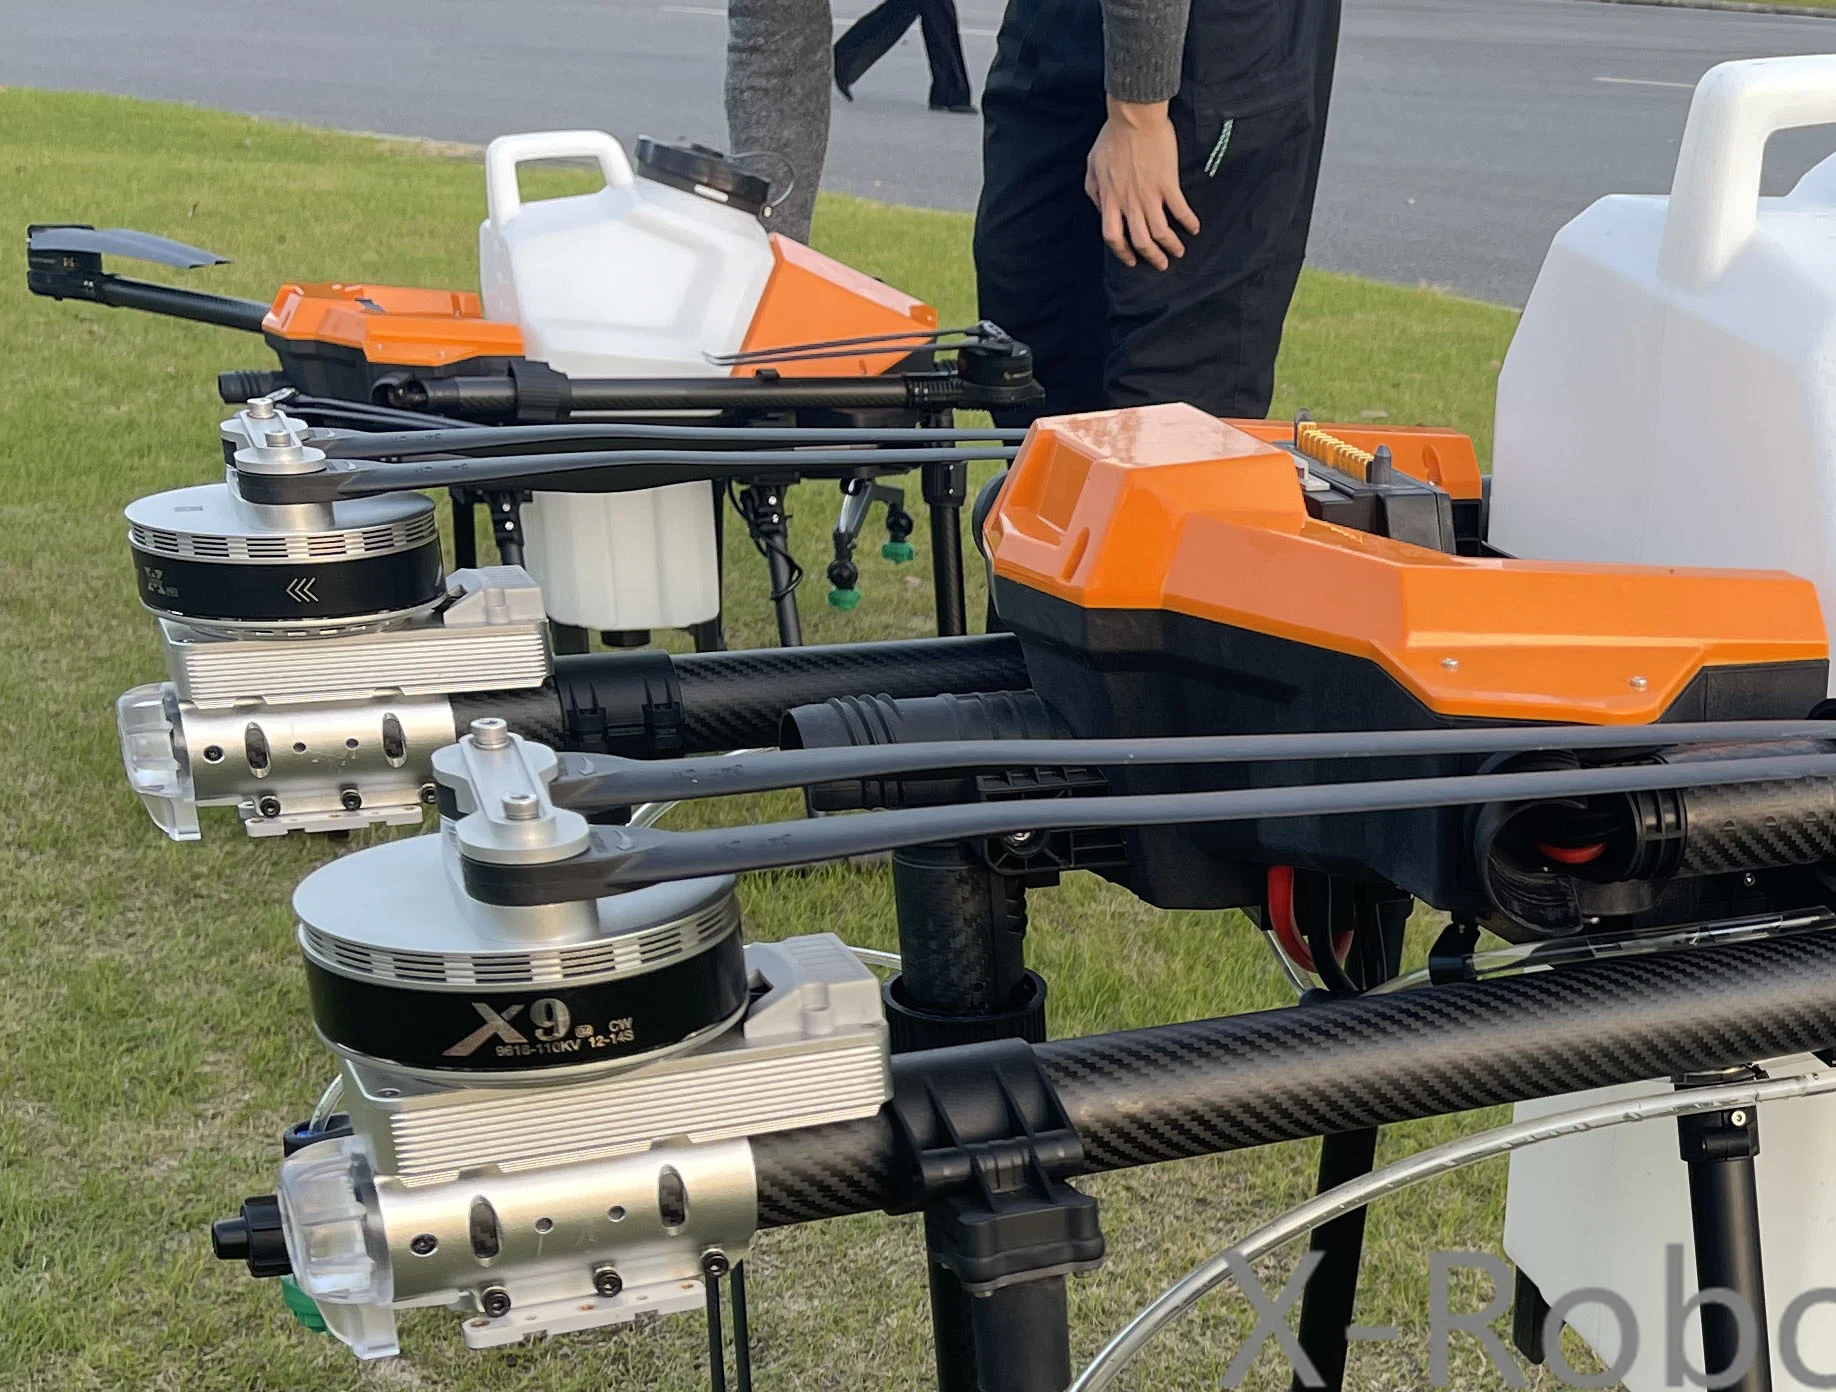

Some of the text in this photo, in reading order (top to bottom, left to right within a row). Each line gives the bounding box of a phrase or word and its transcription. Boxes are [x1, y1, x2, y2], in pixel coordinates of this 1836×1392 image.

[441, 998, 572, 1057] X9
[608, 1017, 633, 1033] CW
[588, 1029, 635, 1049] 12-14S
